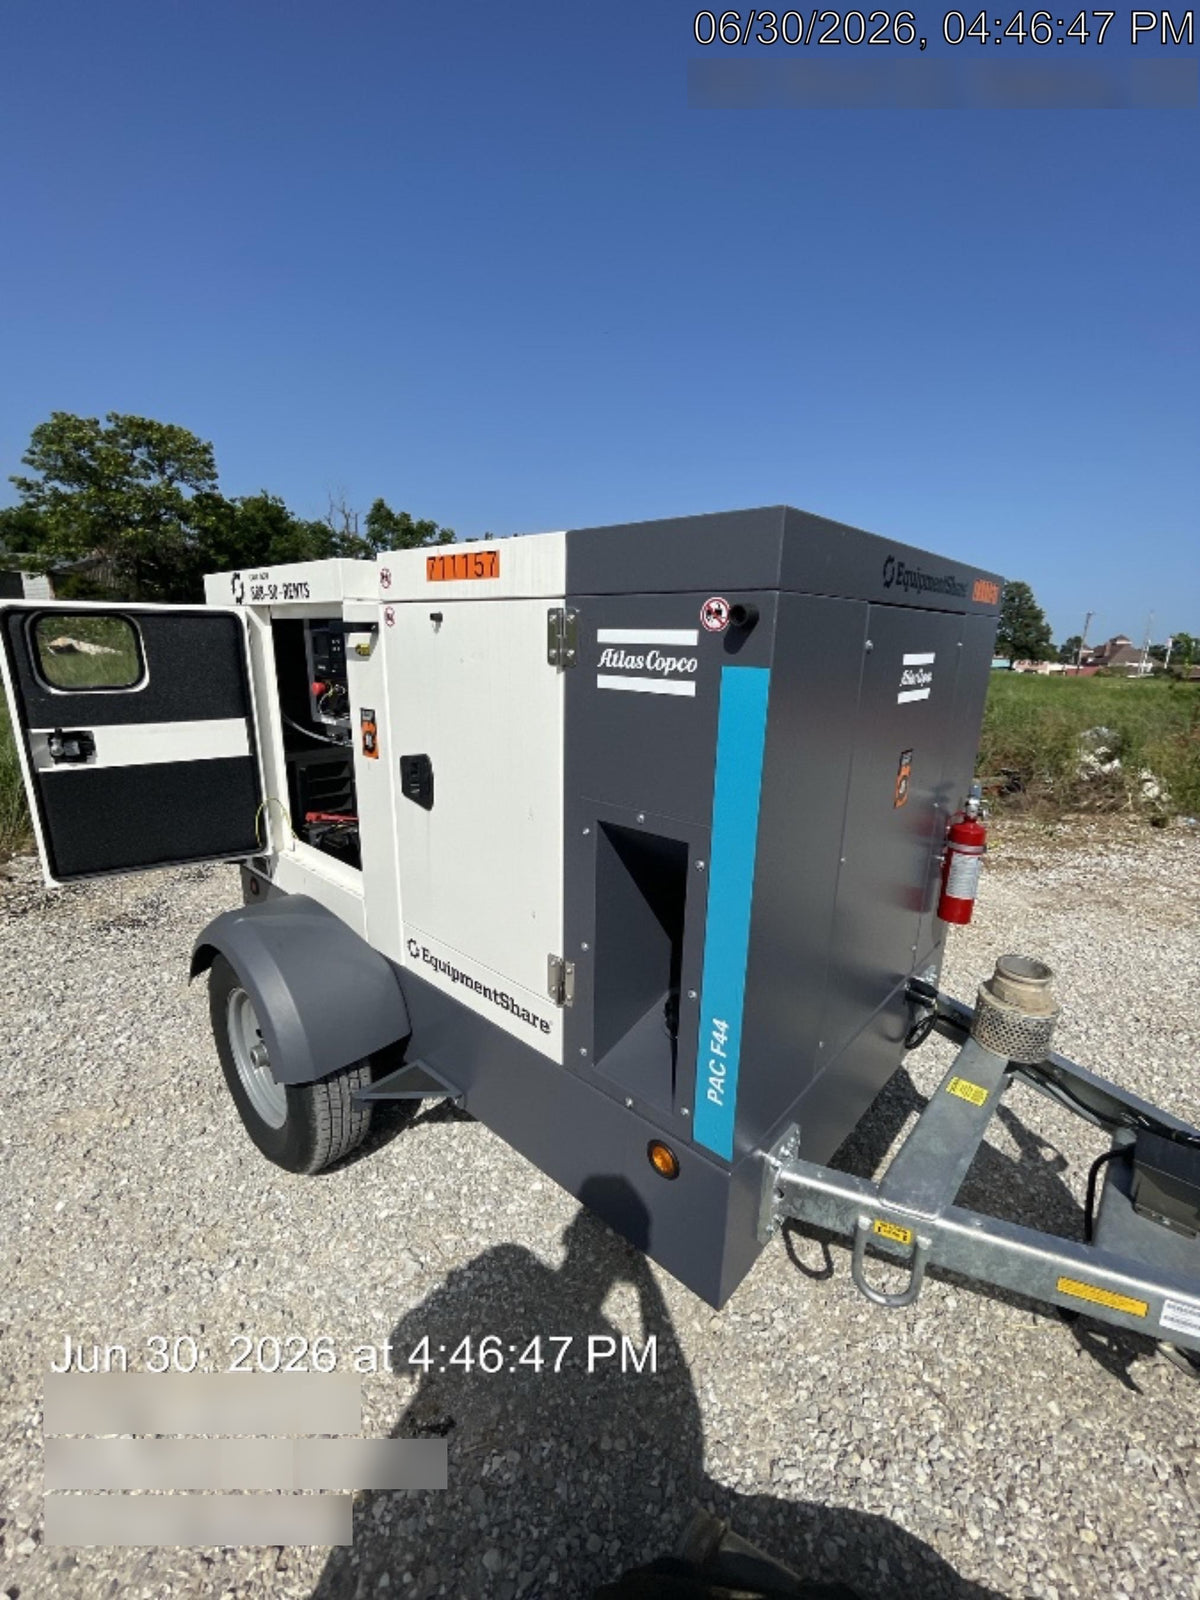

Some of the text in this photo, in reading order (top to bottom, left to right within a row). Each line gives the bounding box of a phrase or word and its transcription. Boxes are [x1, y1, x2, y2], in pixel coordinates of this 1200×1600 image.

[427, 550, 497, 580] 711157
[421, 946, 551, 1034] EquipmentShare
[707, 1018, 730, 1106] PAC F44
